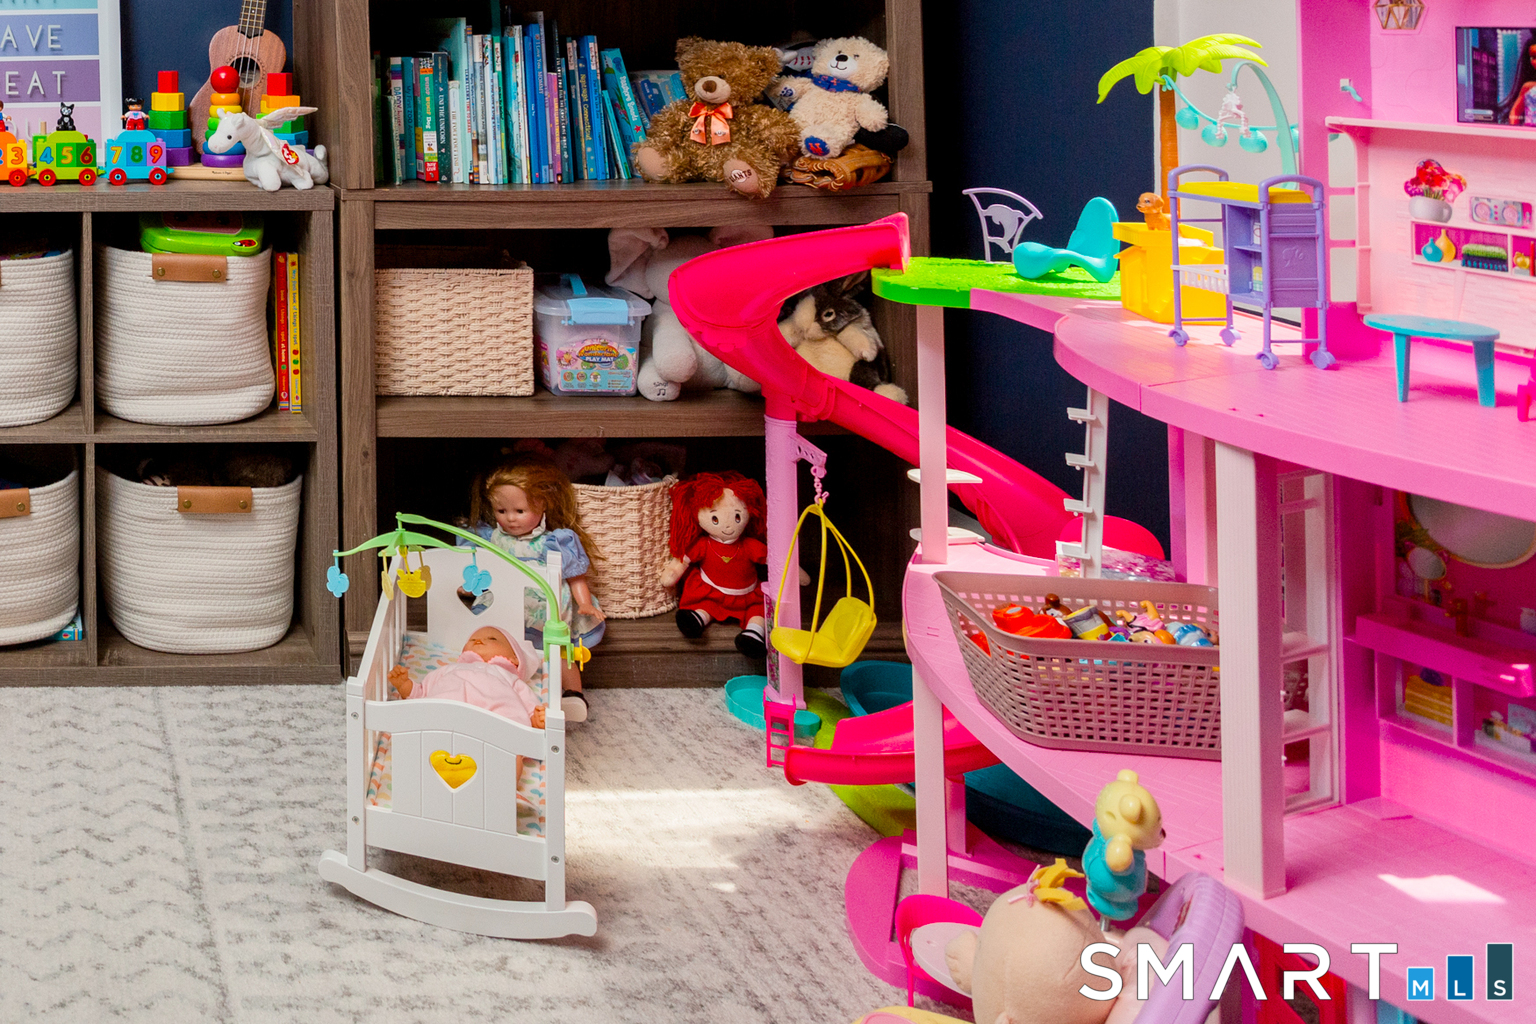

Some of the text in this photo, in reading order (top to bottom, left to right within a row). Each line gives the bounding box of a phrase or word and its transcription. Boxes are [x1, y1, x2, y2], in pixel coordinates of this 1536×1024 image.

[406, 85, 411, 94] My
[626, 101, 638, 121] Sounds
[583, 104, 592, 140] Connecticut
[11, 146, 24, 164] 3
[40, 146, 93, 164] 4 5 6
[110, 144, 162, 164] 7 8 9
